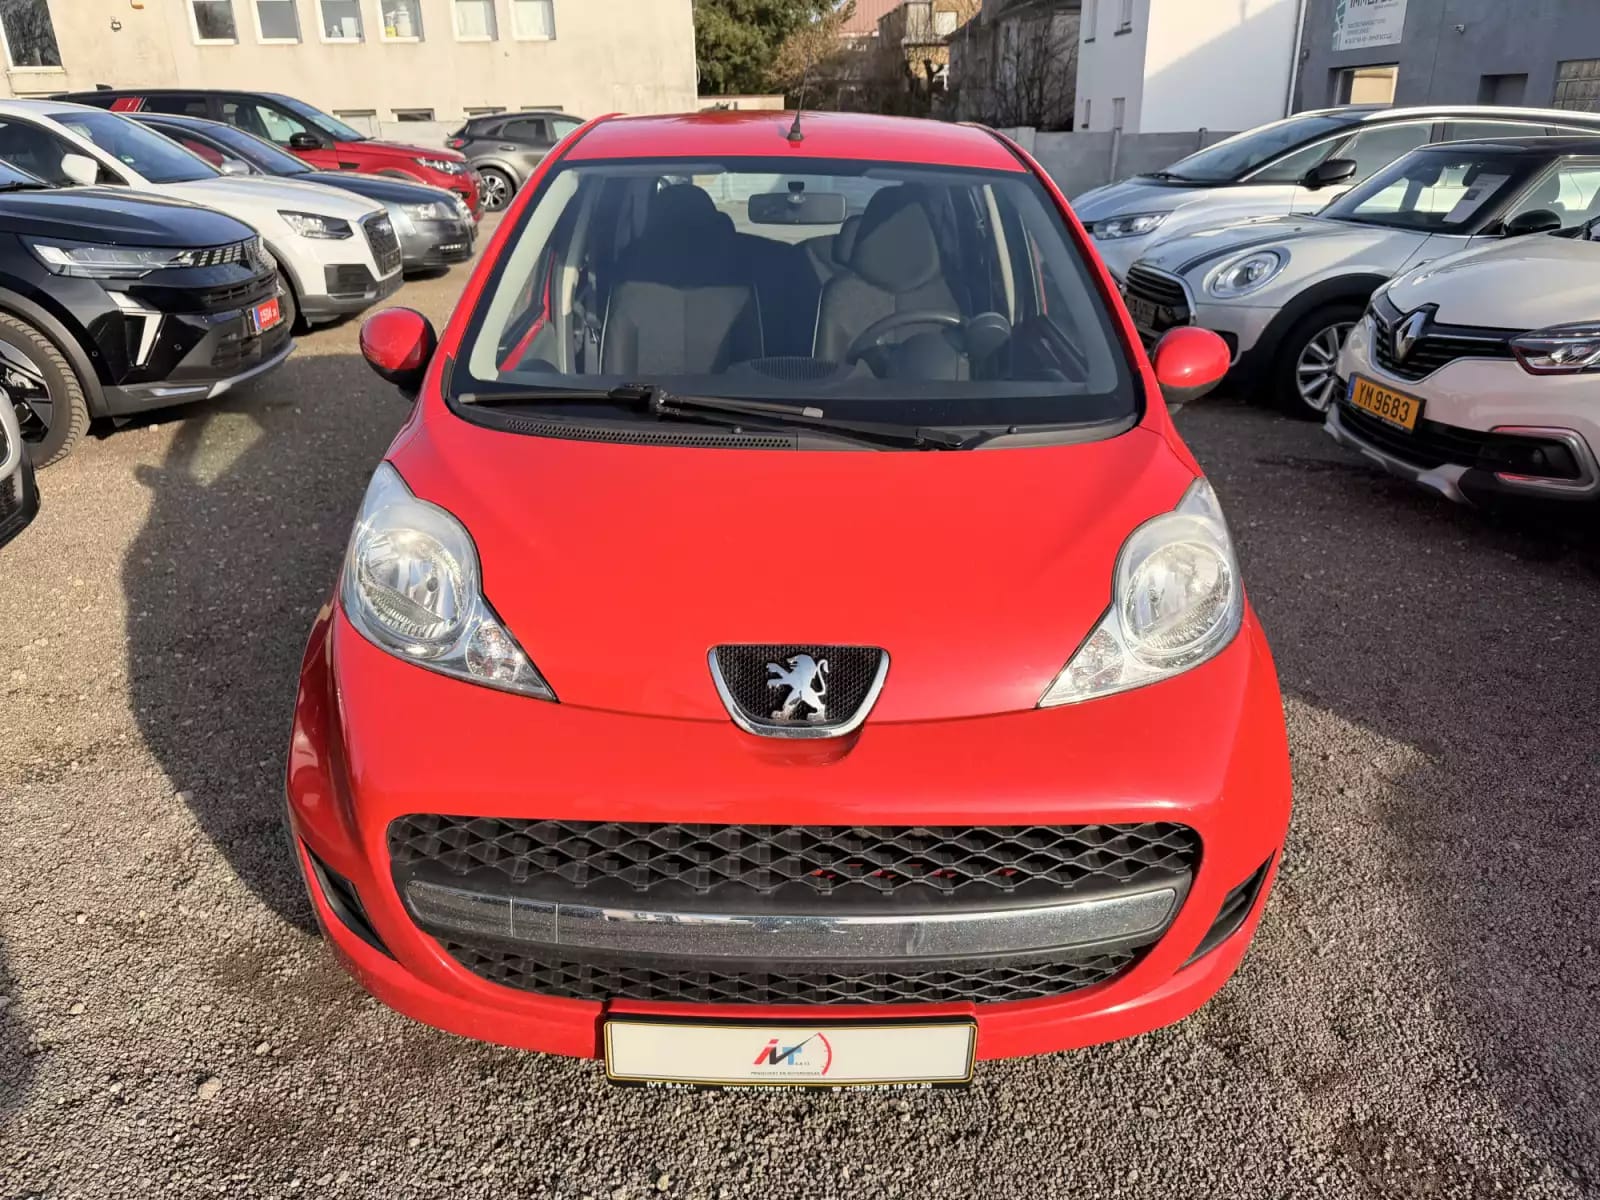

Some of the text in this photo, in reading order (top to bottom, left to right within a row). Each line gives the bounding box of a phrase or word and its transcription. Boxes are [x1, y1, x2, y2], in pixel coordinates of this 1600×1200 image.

[1358, 382, 1410, 423] YN 9683
[646, 1081, 662, 1089] IVT
